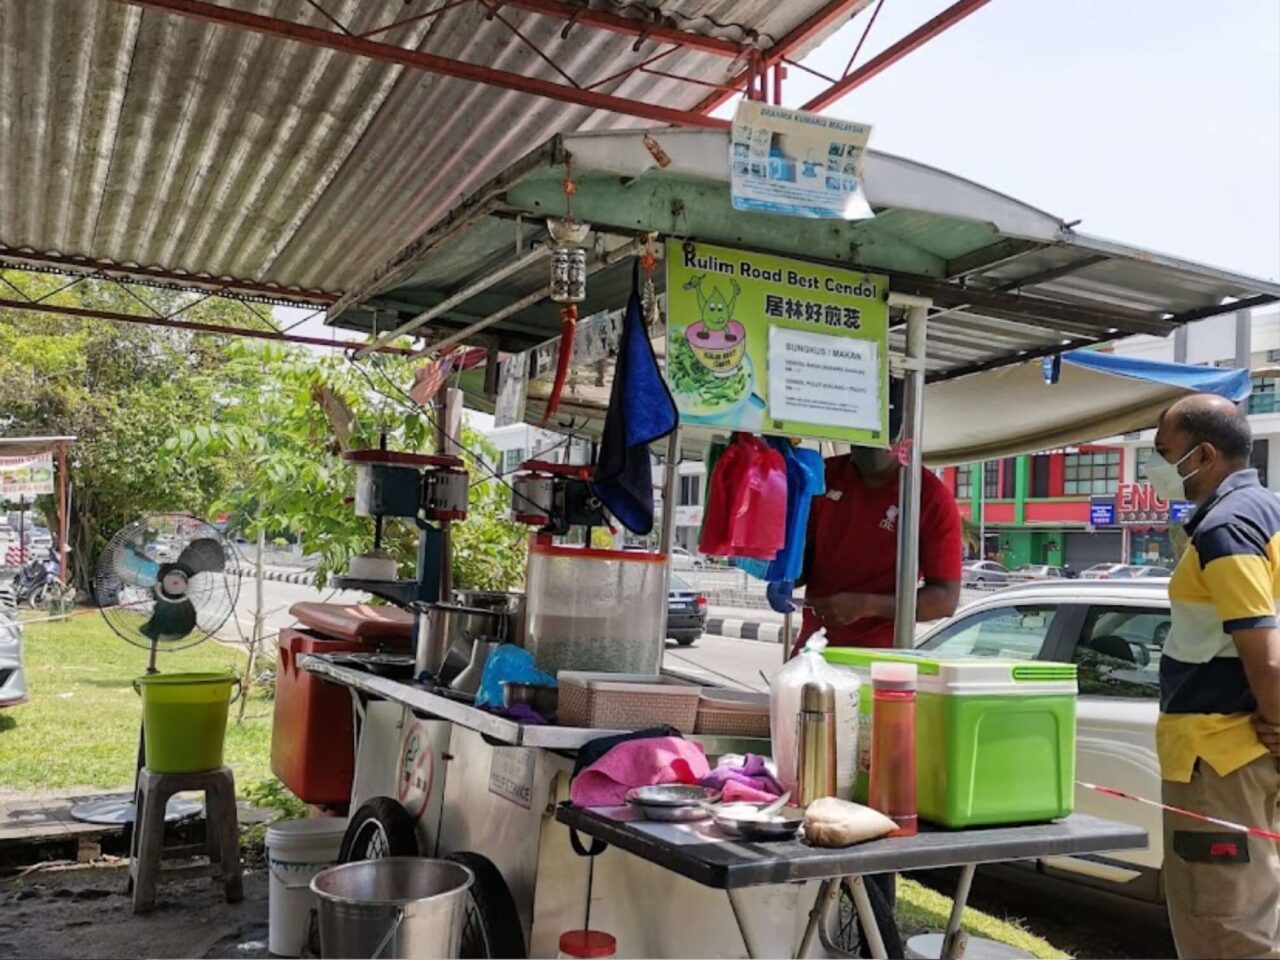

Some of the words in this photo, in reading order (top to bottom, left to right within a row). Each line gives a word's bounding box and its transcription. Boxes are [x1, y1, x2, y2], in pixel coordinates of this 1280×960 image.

[684, 250, 734, 275] Kulim
[740, 261, 782, 283] Road
[787, 269, 820, 290] Best
[825, 277, 877, 299] Cendol
[785, 342, 827, 356] BUNGKUS
[832, 348, 862, 360] MAKAN
